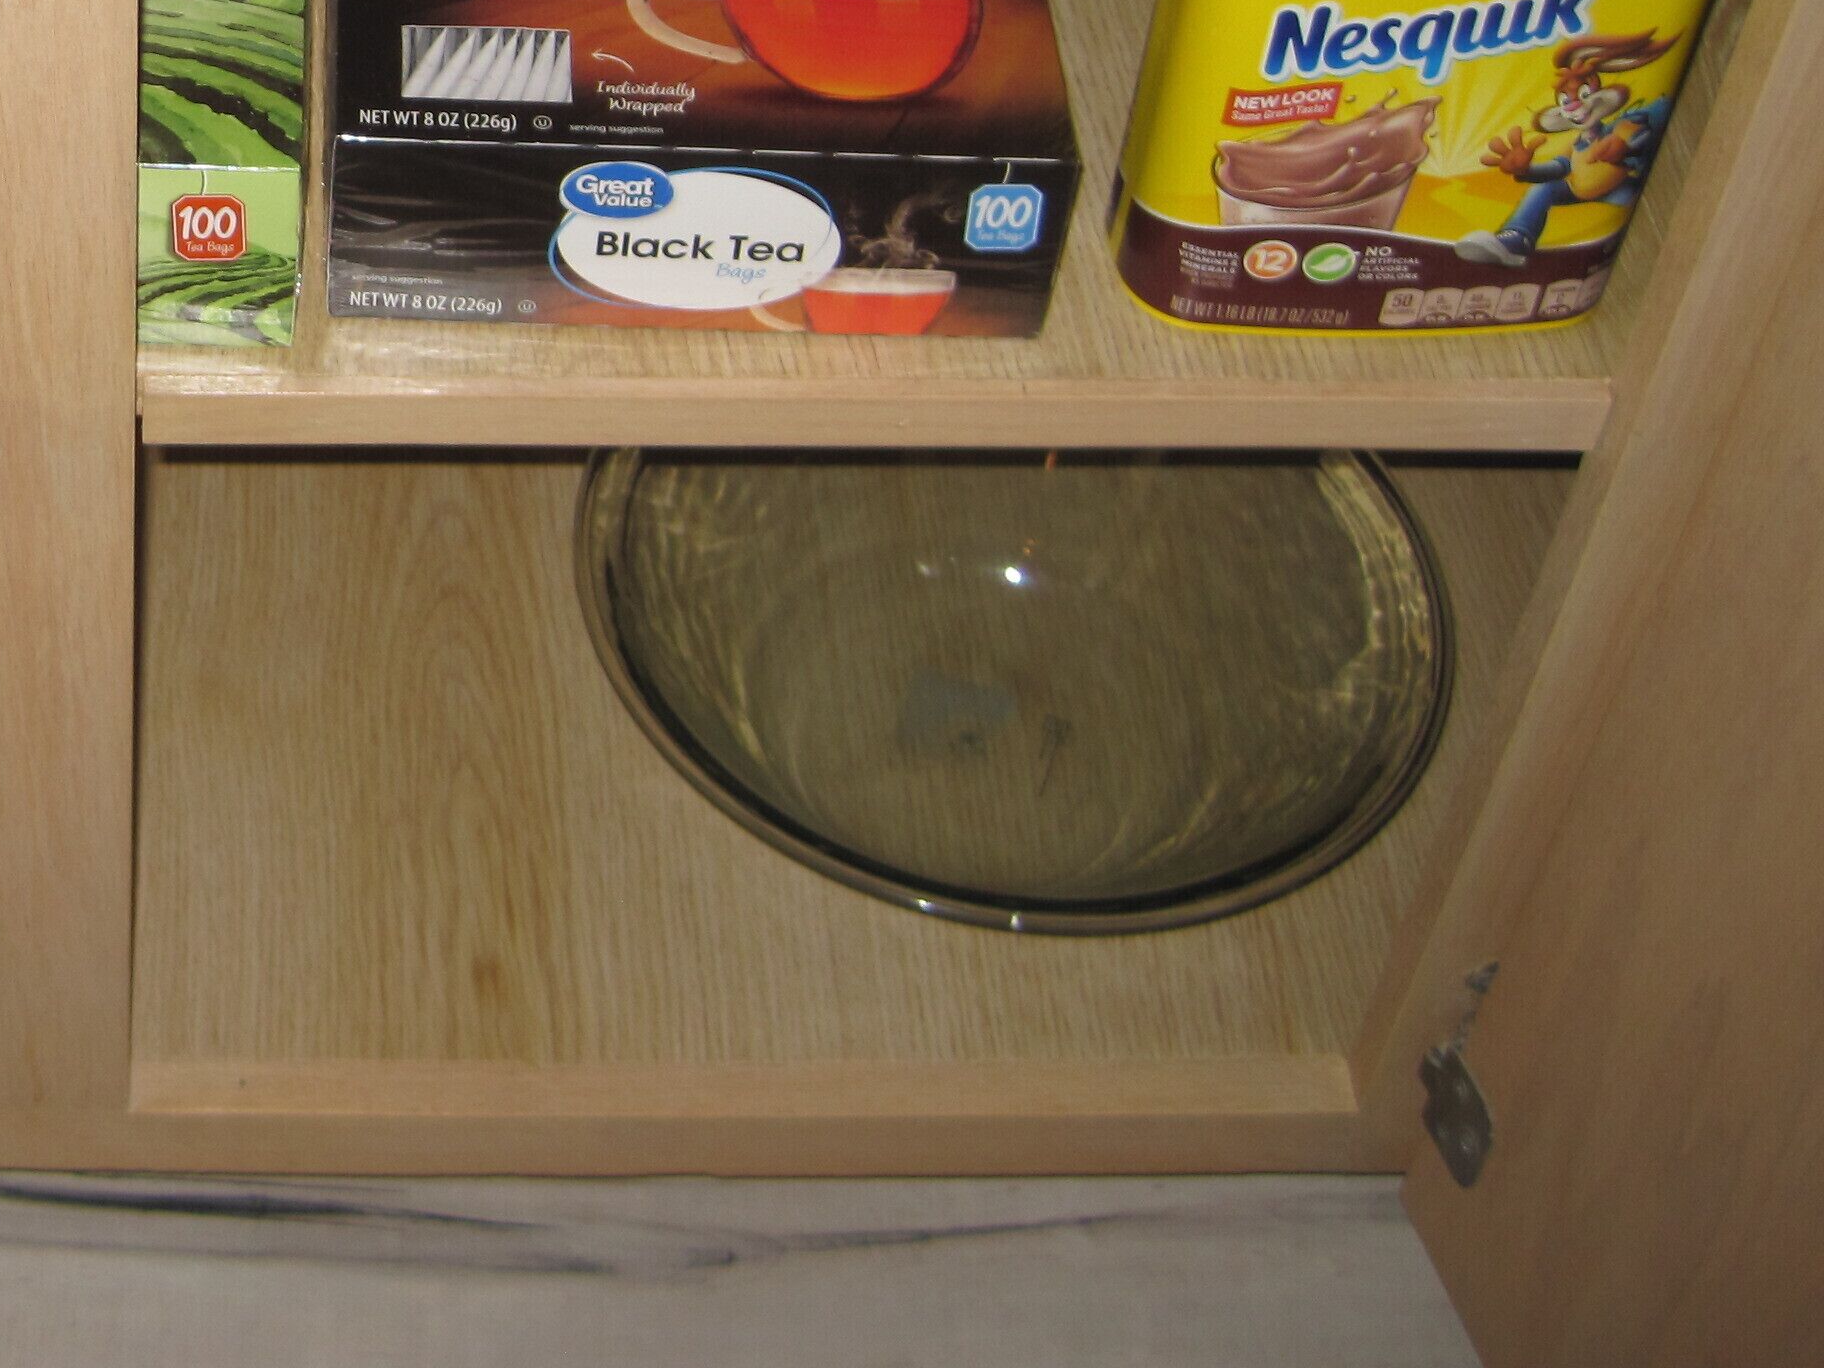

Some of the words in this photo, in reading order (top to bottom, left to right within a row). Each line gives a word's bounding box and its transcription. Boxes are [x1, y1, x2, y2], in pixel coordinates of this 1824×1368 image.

[596, 80, 696, 102] Individually
[1233, 95, 1280, 109] NEW
[1281, 88, 1335, 106] LOOK
[608, 97, 685, 116] Wrapped
[1231, 109, 1262, 120] Same
[1263, 107, 1294, 119] Great
[1296, 103, 1329, 115] Taste!
[359, 110, 390, 125] NET
[393, 111, 419, 126] WT
[423, 112, 434, 126] 8
[438, 113, 460, 127] OZ
[464, 113, 517, 132] (226g)
[569, 123, 606, 133] serving
[608, 125, 664, 134] suggestion
[576, 174, 655, 196] Great
[593, 193, 653, 208] Value
[179, 205, 237, 240] 100
[975, 195, 1033, 229] 100
[187, 241, 204, 252] Tea
[207, 240, 235, 256] Bags
[596, 231, 715, 260] Black
[729, 235, 805, 262] Tea
[1364, 246, 1392, 257] NO
[1256, 246, 1285, 272] 12
[716, 263, 768, 283] Bags
[349, 291, 379, 307] NET
[382, 292, 409, 308] WT
[412, 294, 422, 309] 8
[426, 295, 447, 310] OZ
[451, 297, 502, 315] (226g)
